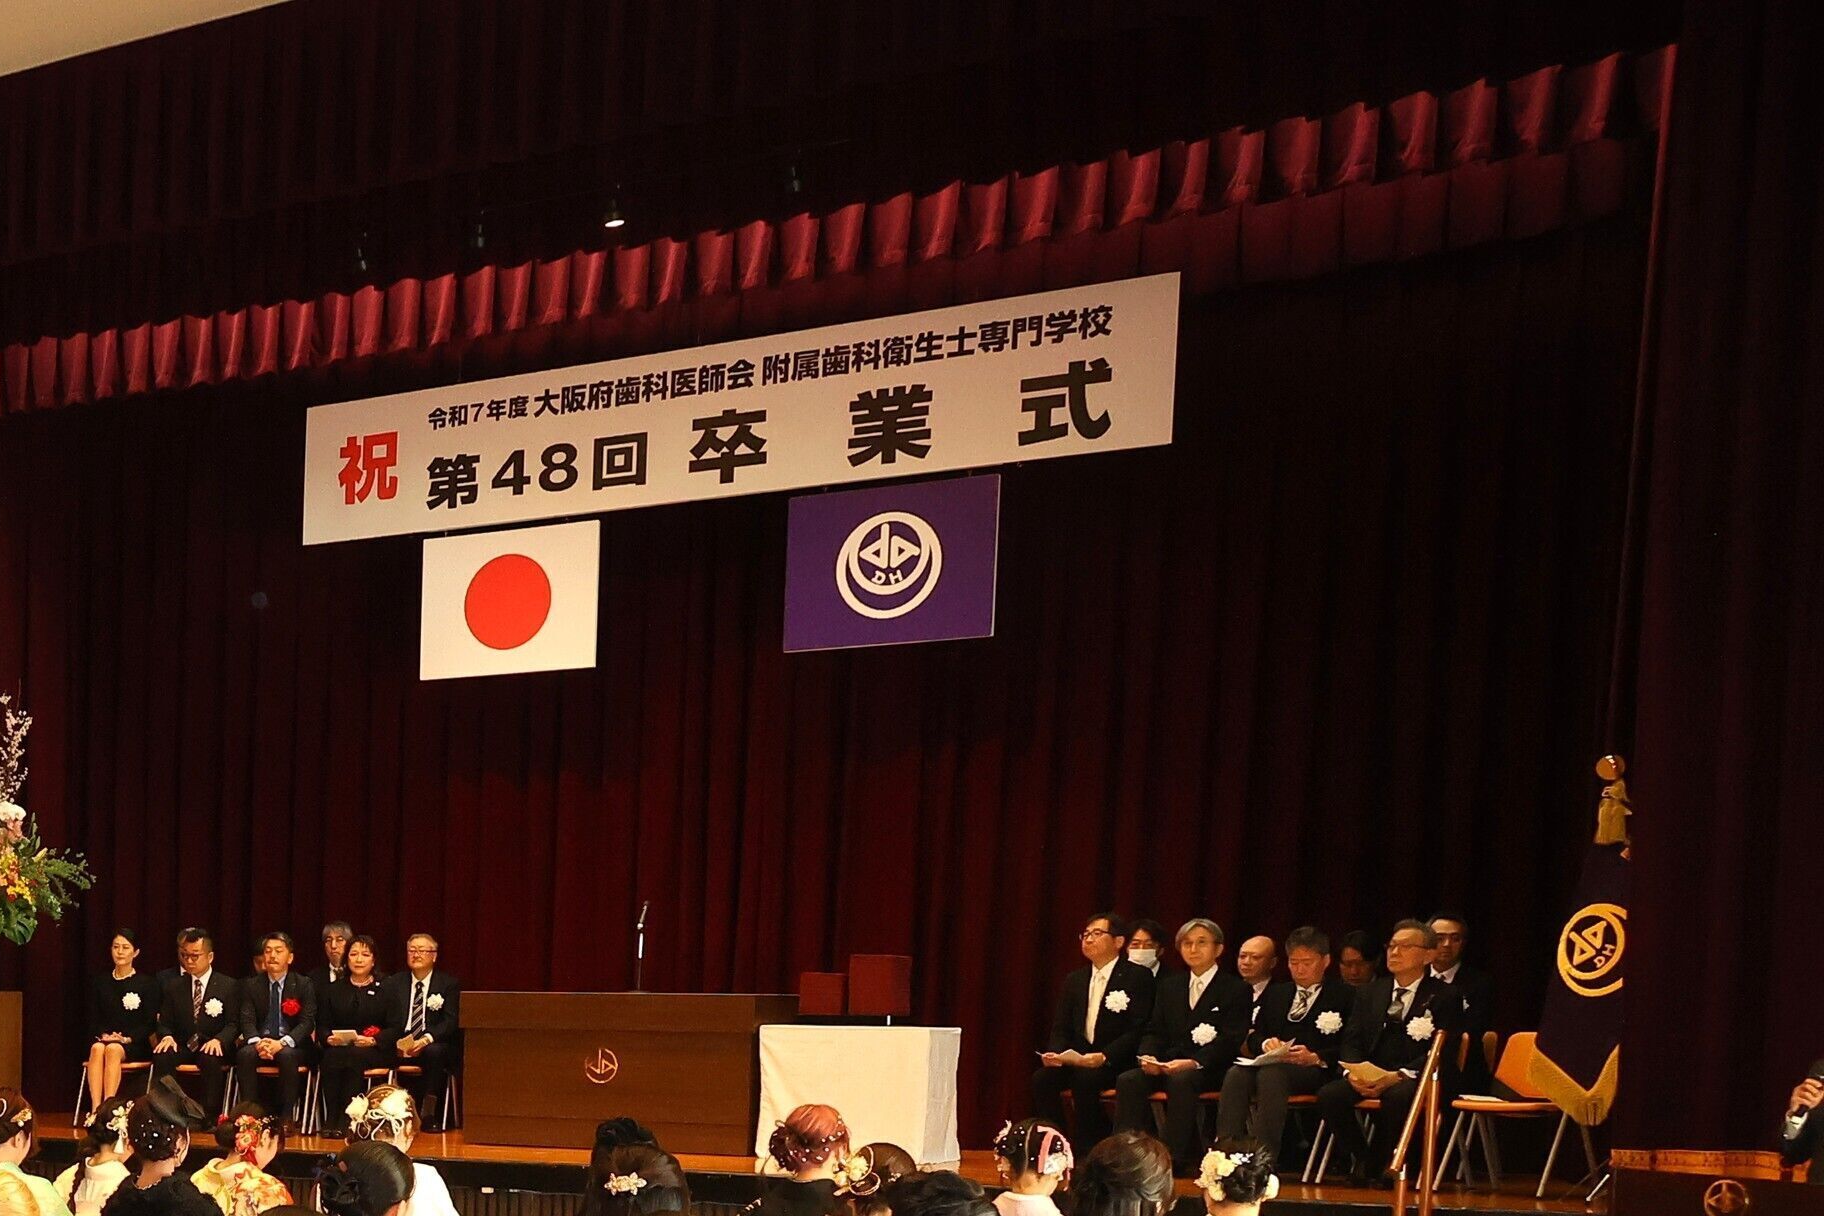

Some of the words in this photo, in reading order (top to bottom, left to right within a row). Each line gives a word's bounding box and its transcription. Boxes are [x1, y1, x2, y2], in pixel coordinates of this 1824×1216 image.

[427, 394, 530, 431] 令和7年度
[533, 357, 755, 419] 大阪府歯科医師会
[761, 304, 1114, 387] 附属歯科衛生士専門学校
[337, 430, 399, 506] 祝
[425, 431, 649, 511] 第48回
[687, 356, 1113, 485] 卒業式
[870, 568, 904, 585] DH
[1593, 943, 1617, 968] DH
